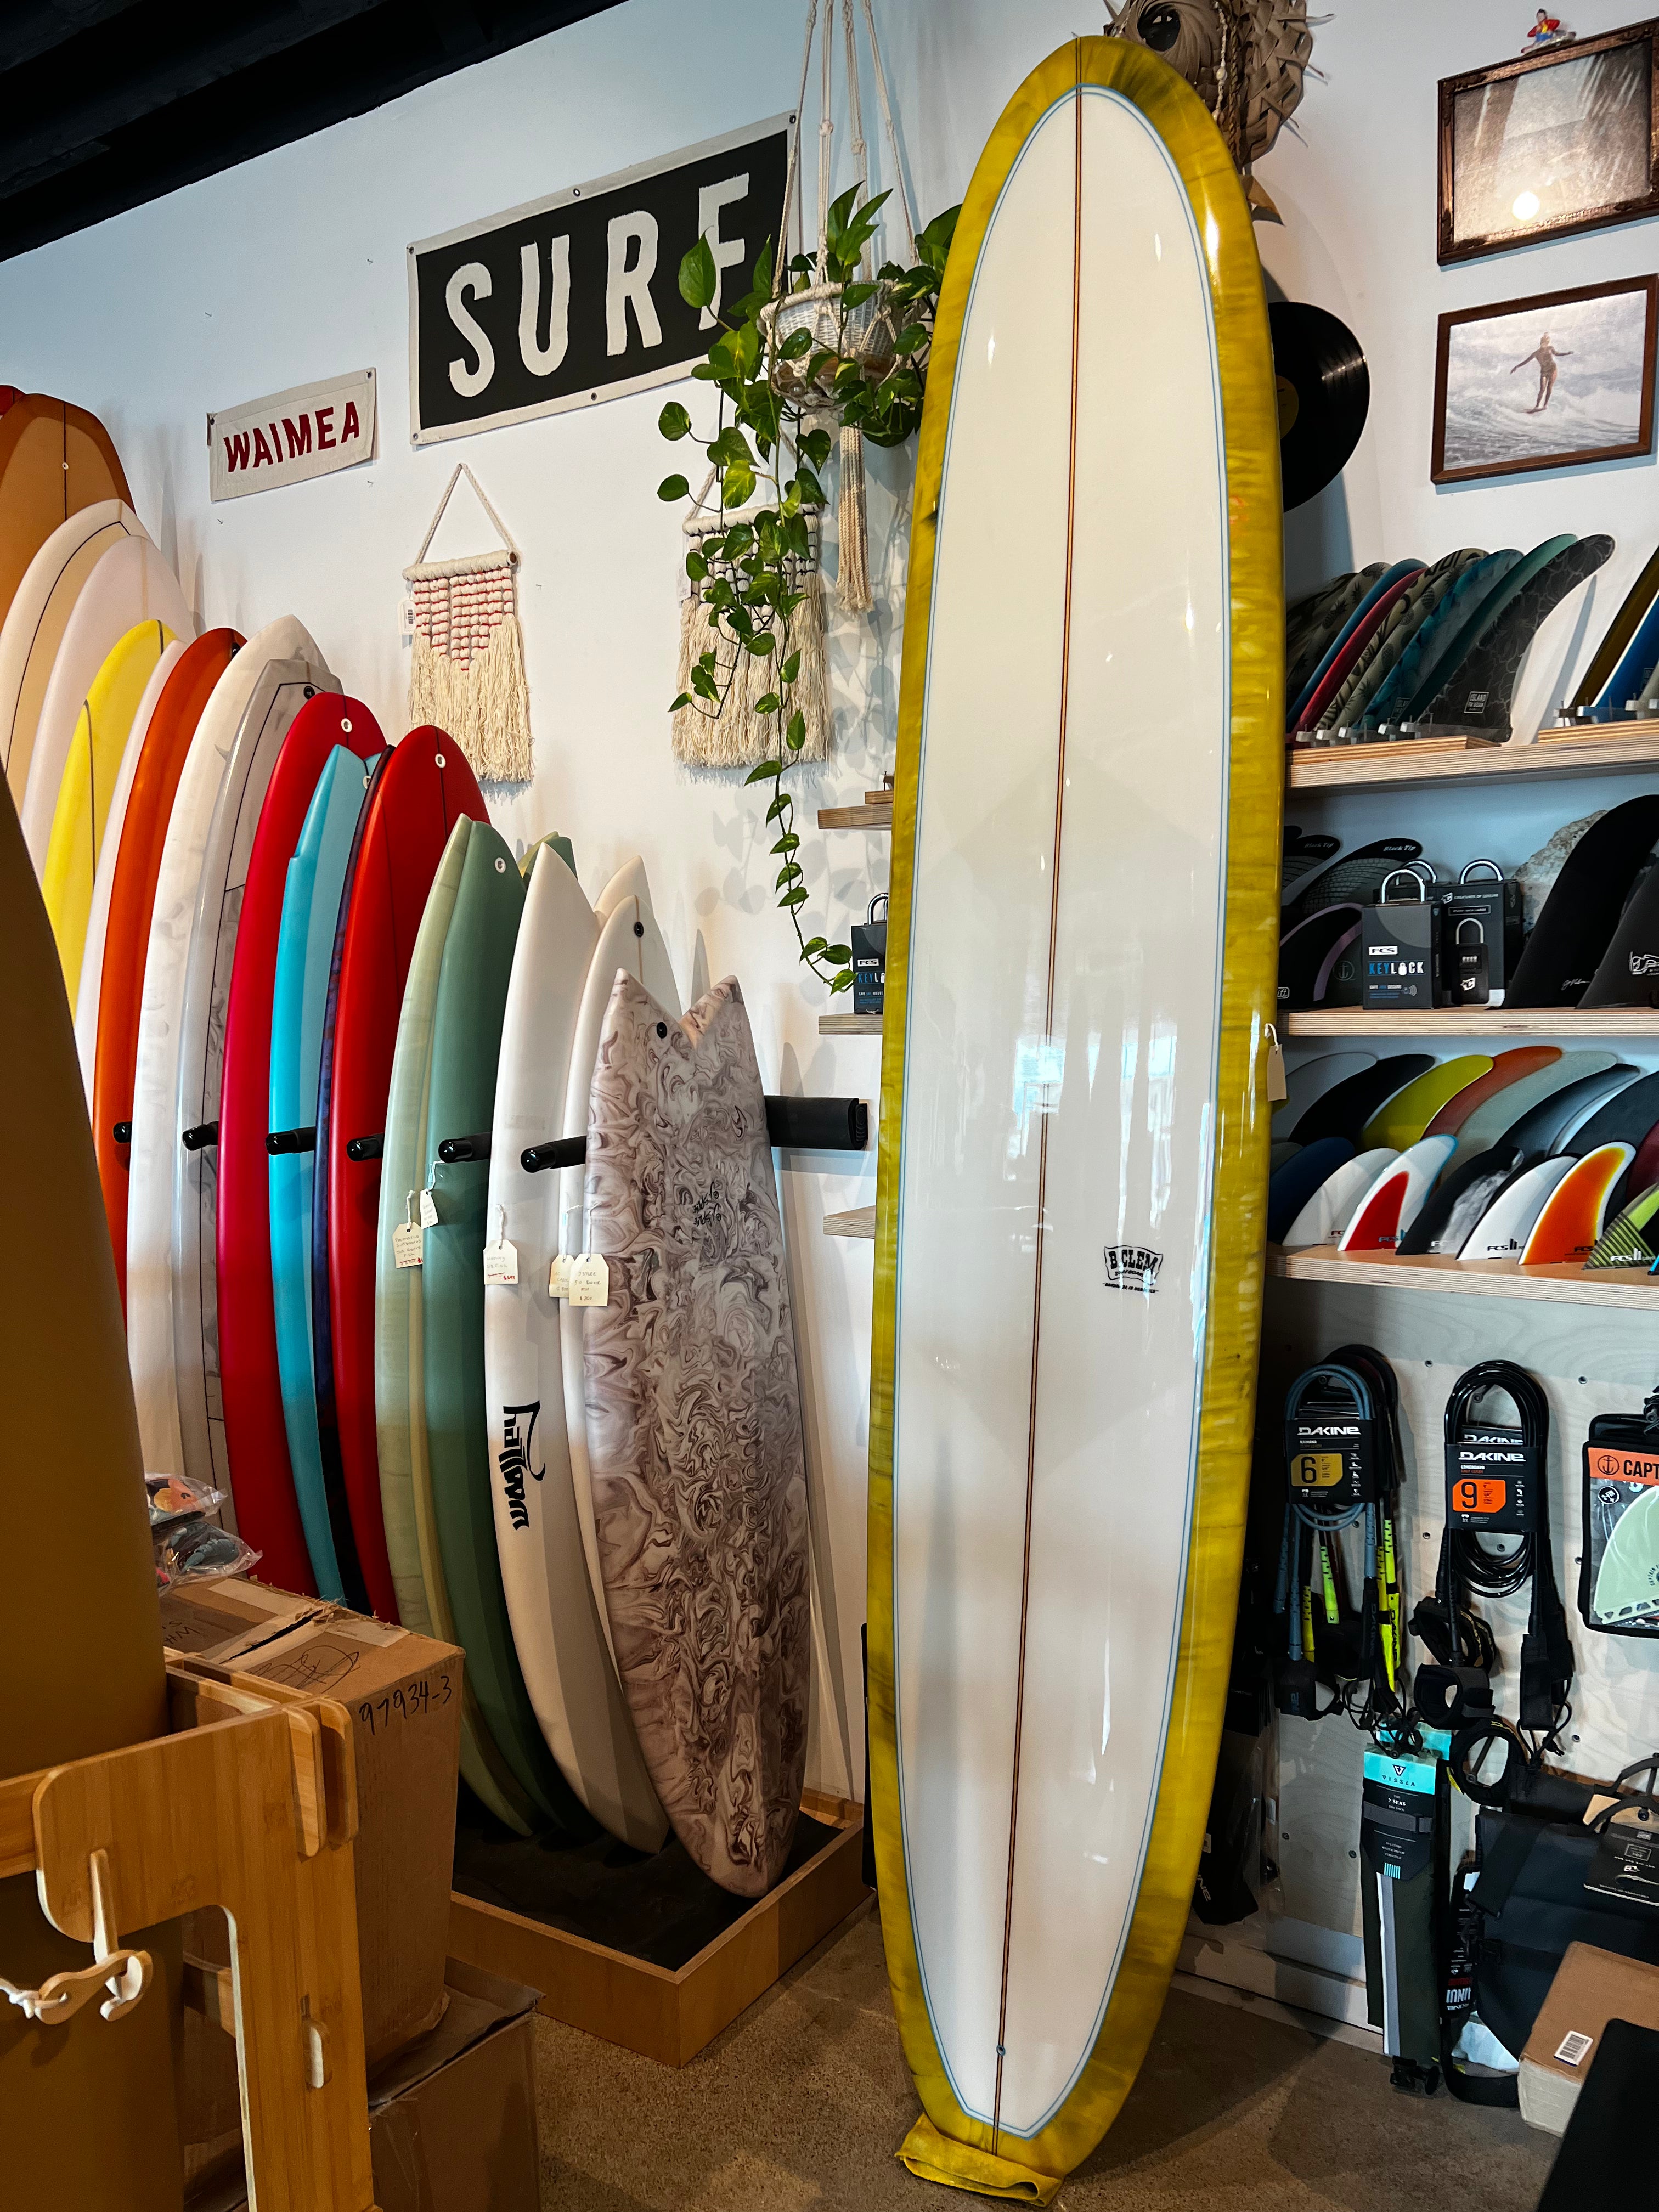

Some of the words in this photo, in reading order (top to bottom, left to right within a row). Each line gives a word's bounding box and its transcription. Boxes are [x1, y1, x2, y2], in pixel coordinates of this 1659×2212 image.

[445, 172, 749, 397] SURF
[224, 400, 360, 472] WAIMEA
[1369, 962, 1424, 975] KEYLOCK
[1108, 1251, 1118, 1269] B
[1122, 1249, 1159, 1274] CLEM
[1297, 1426, 1362, 1435] DAKINE
[1458, 1452, 1527, 1462] DAKINE
[1301, 1457, 1317, 1483] 6
[1623, 1459, 1659, 1480] CAPT
[1461, 1481, 1477, 1509] 9
[1382, 1774, 1415, 1787] VISSLA
